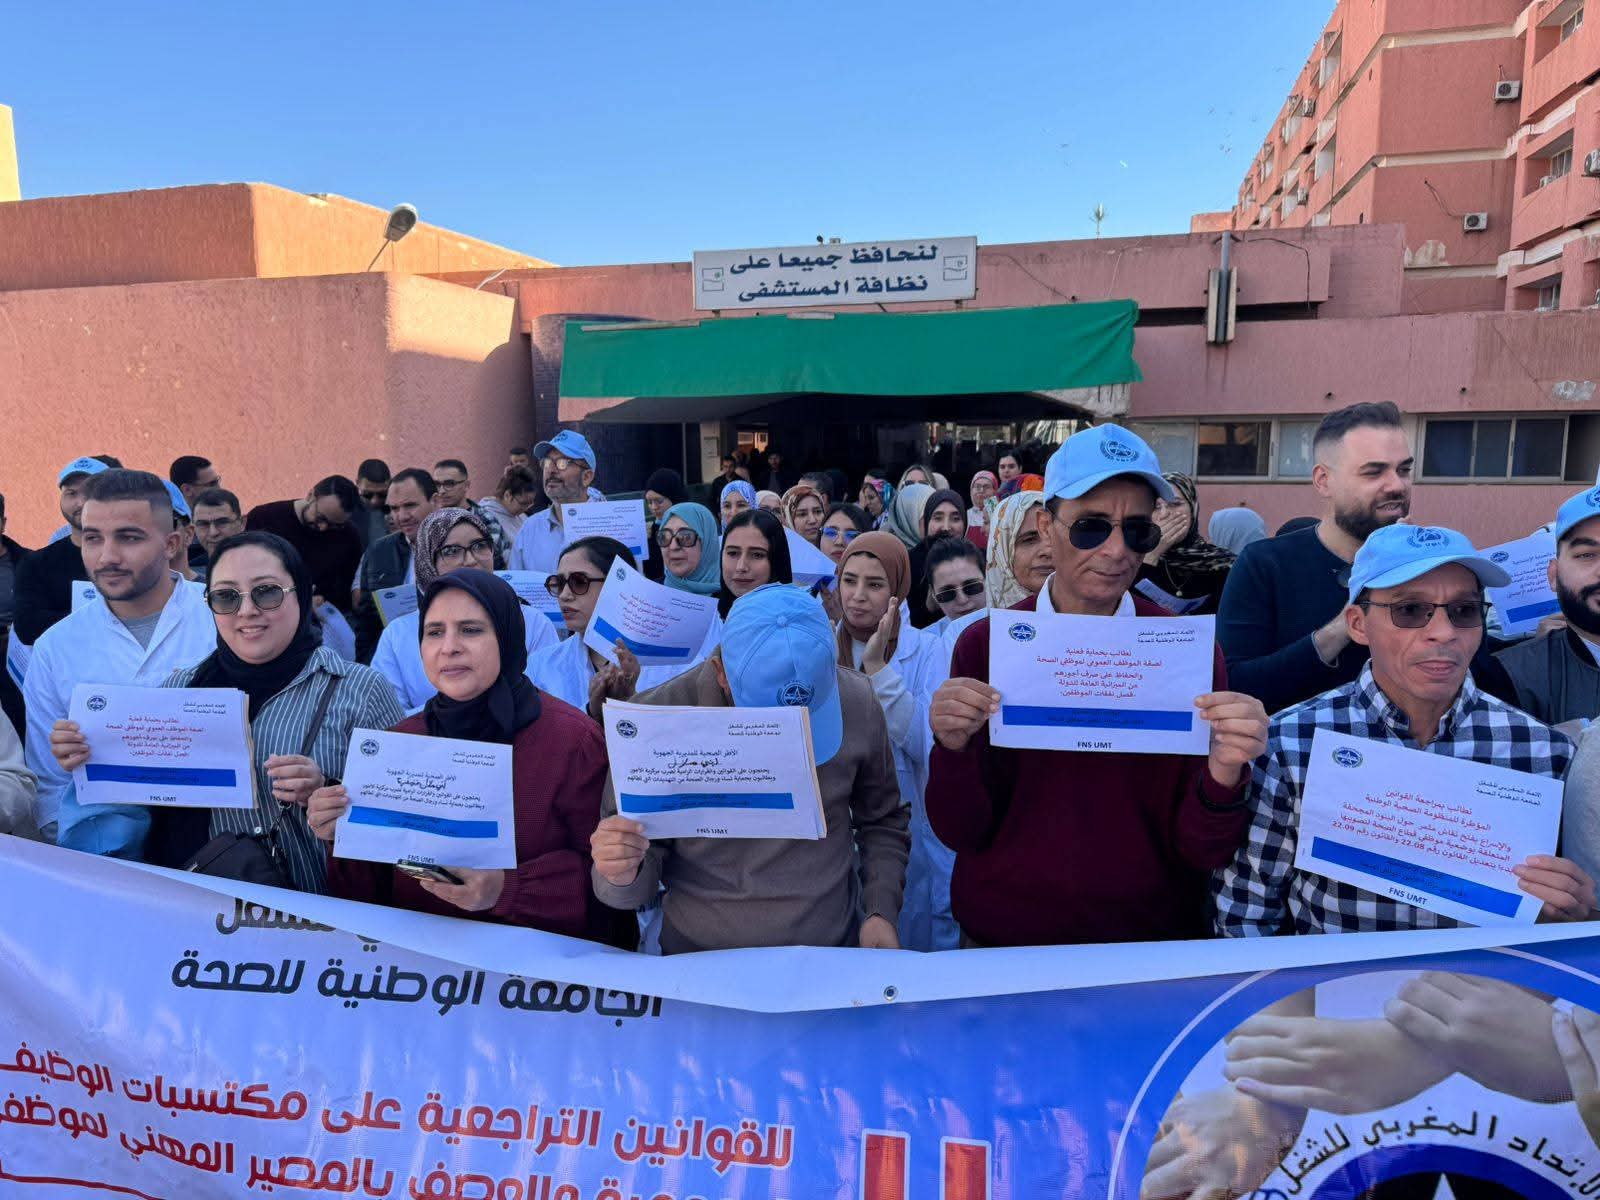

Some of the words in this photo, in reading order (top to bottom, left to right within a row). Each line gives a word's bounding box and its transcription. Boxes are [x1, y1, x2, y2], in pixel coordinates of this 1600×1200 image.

[730, 254, 771, 274] على
[778, 252, 841, 271] جميعا
[850, 244, 939, 264] لنحافظ
[738, 279, 848, 302] المستشفى
[856, 275, 928, 293] نظافة
[1332, 821, 1354, 831] 22.09
[1401, 839, 1424, 849] 22.08
[1389, 887, 1405, 897] FNS
[1407, 893, 1428, 904] UMT
[171, 949, 305, 993] للصحة
[317, 958, 485, 1016] الوطنية
[0, 1040, 114, 1097] الوظيف
[0, 1092, 108, 1139] لموظف
[122, 1076, 307, 1120] مكتسبات
[321, 1091, 401, 1134] على
[418, 1092, 601, 1156] التراجعية
[1363, 1106, 1497, 1146] المغربي
[120, 1125, 234, 1174] المهني
[613, 1118, 793, 1174] للقوانين
[1280, 1123, 1350, 1194] للشغل
[246, 1155, 394, 1197] بالمصير
